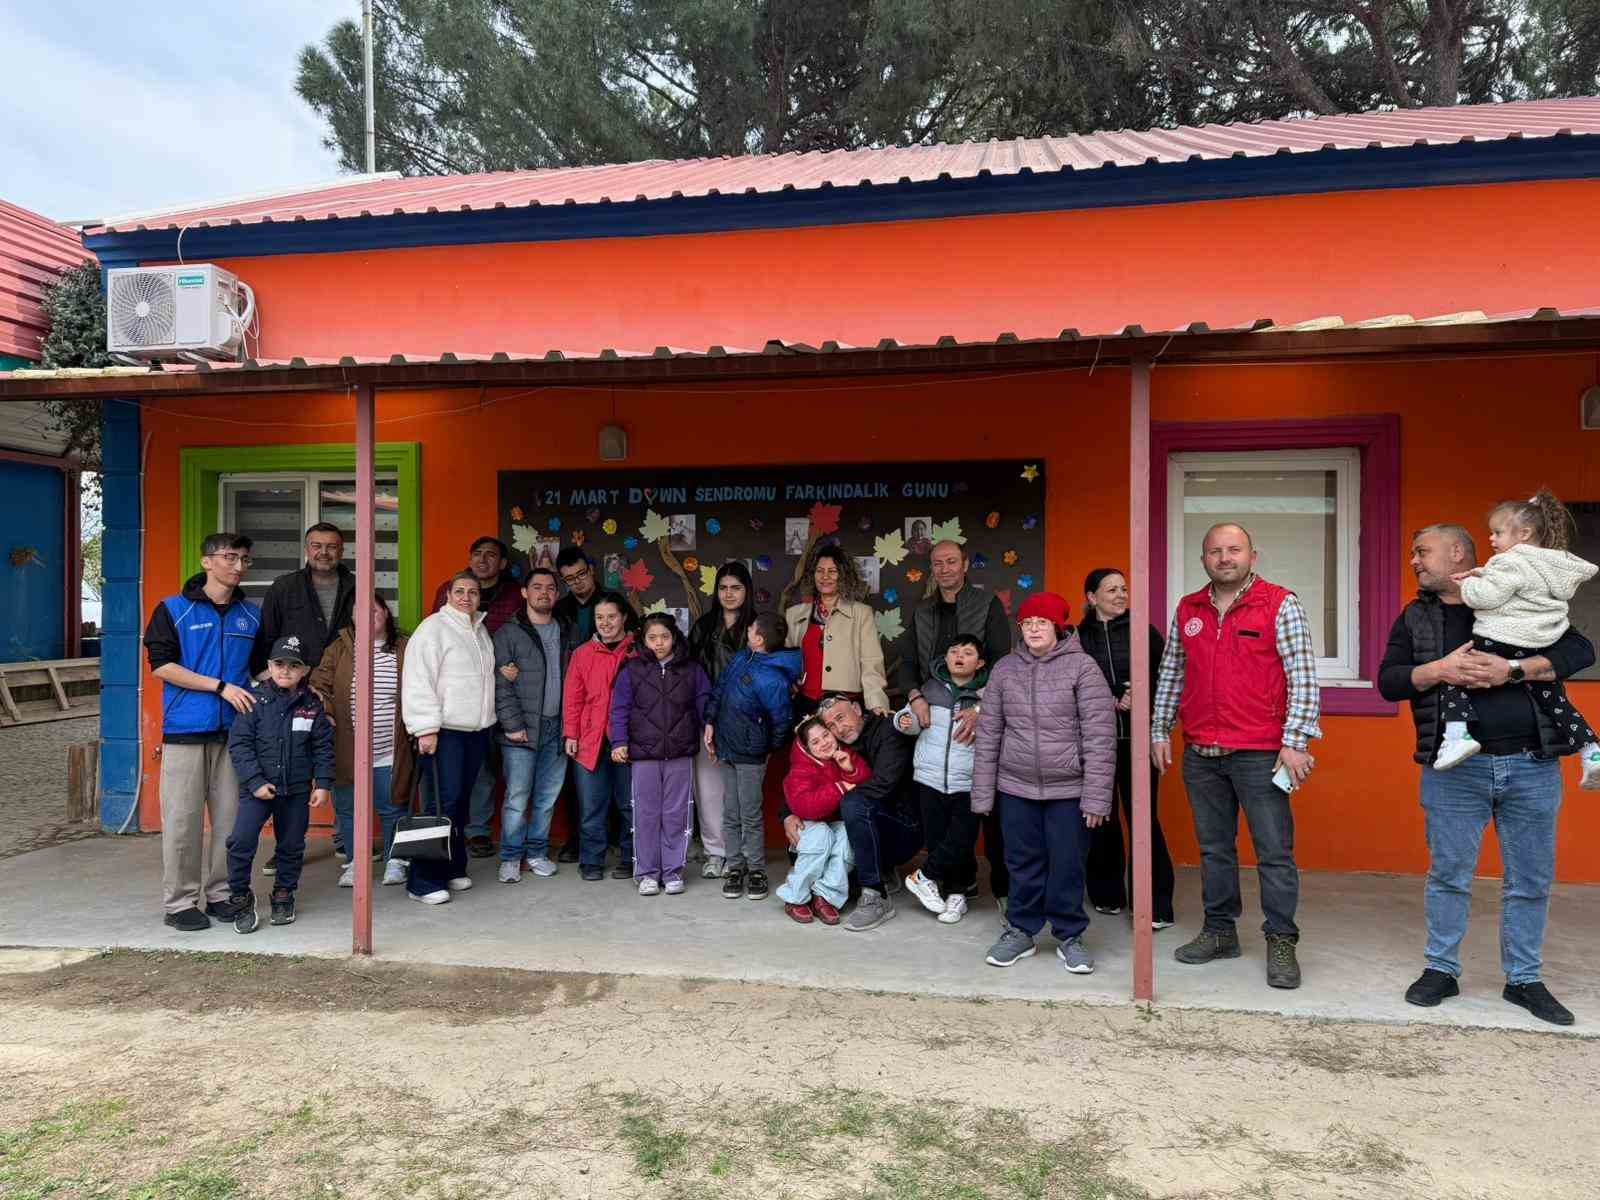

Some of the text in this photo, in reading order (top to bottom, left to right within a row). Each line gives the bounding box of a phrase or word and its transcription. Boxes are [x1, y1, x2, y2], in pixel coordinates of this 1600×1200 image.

[544, 488, 561, 505] 21
[569, 488, 620, 506] MART
[695, 485, 777, 503] SENDROMU
[784, 481, 889, 501] FARKINDALIK
[901, 481, 950, 499] GUNU
